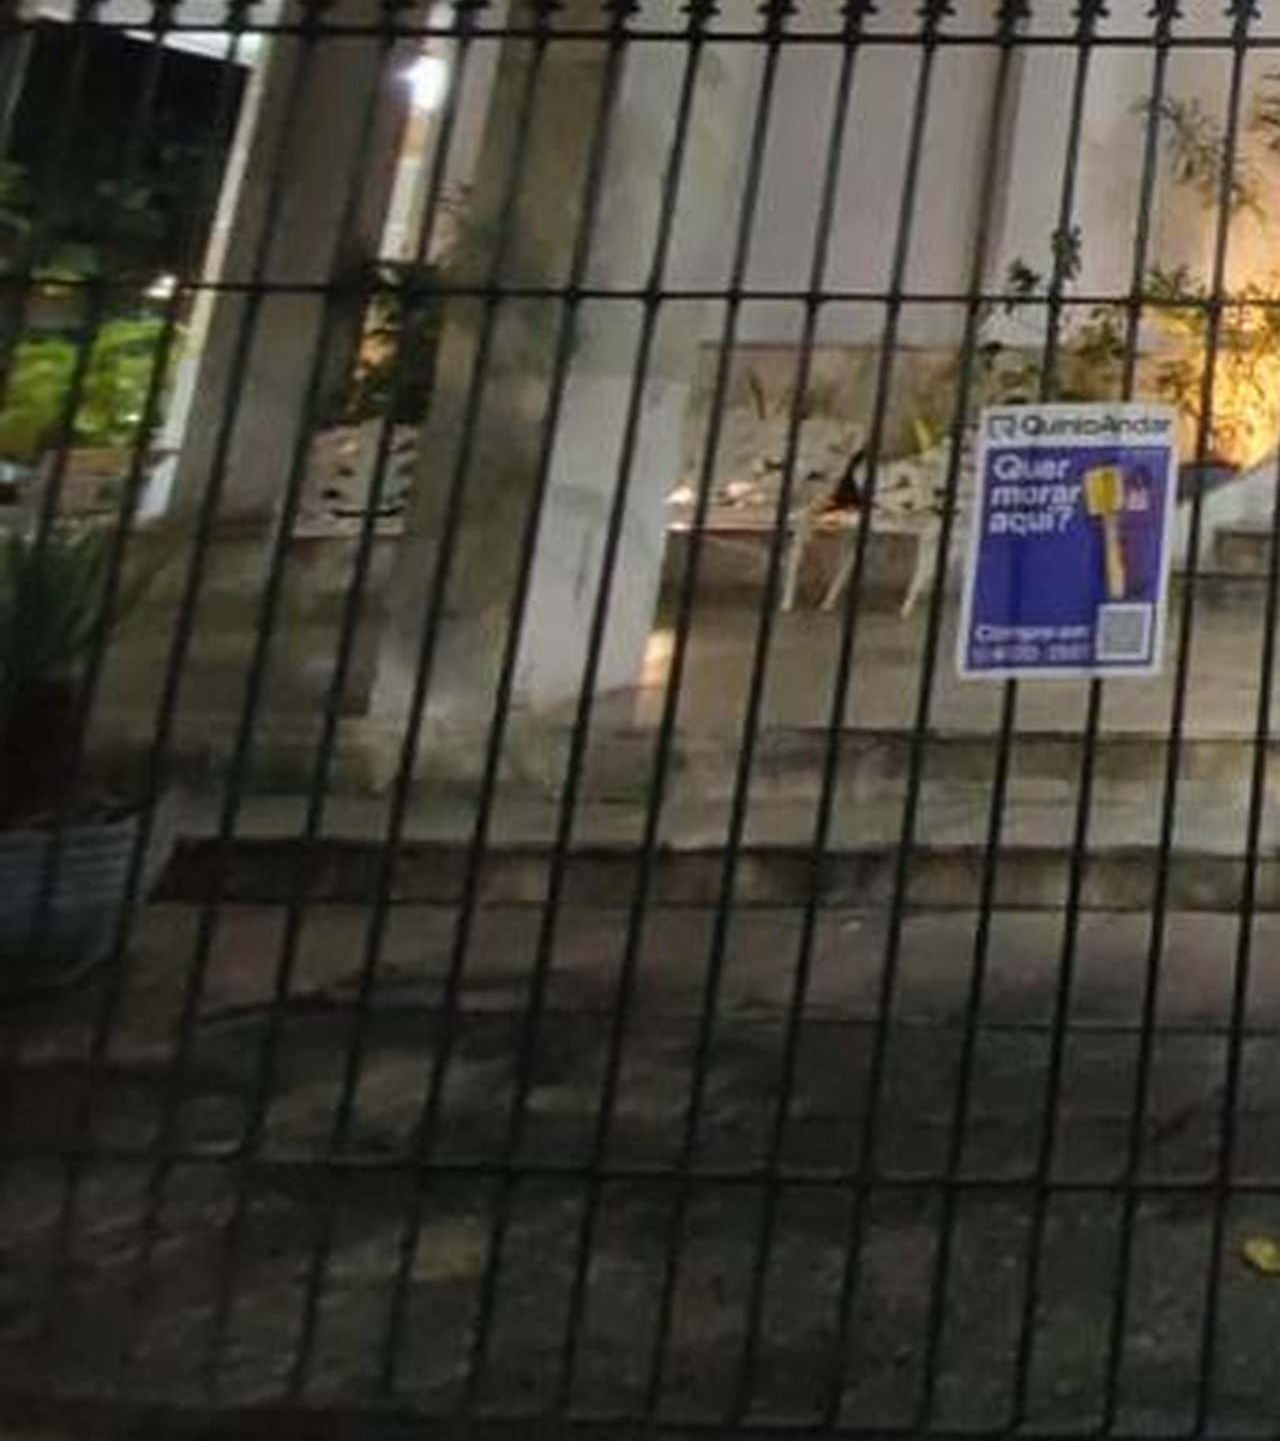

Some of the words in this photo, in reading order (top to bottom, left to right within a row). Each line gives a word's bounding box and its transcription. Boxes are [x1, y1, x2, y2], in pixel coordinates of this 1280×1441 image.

[1021, 414, 1172, 437] QuintoAndar
[993, 453, 1071, 479] Quer
[990, 484, 1081, 505] morar
[989, 505, 1072, 536] aqui?
